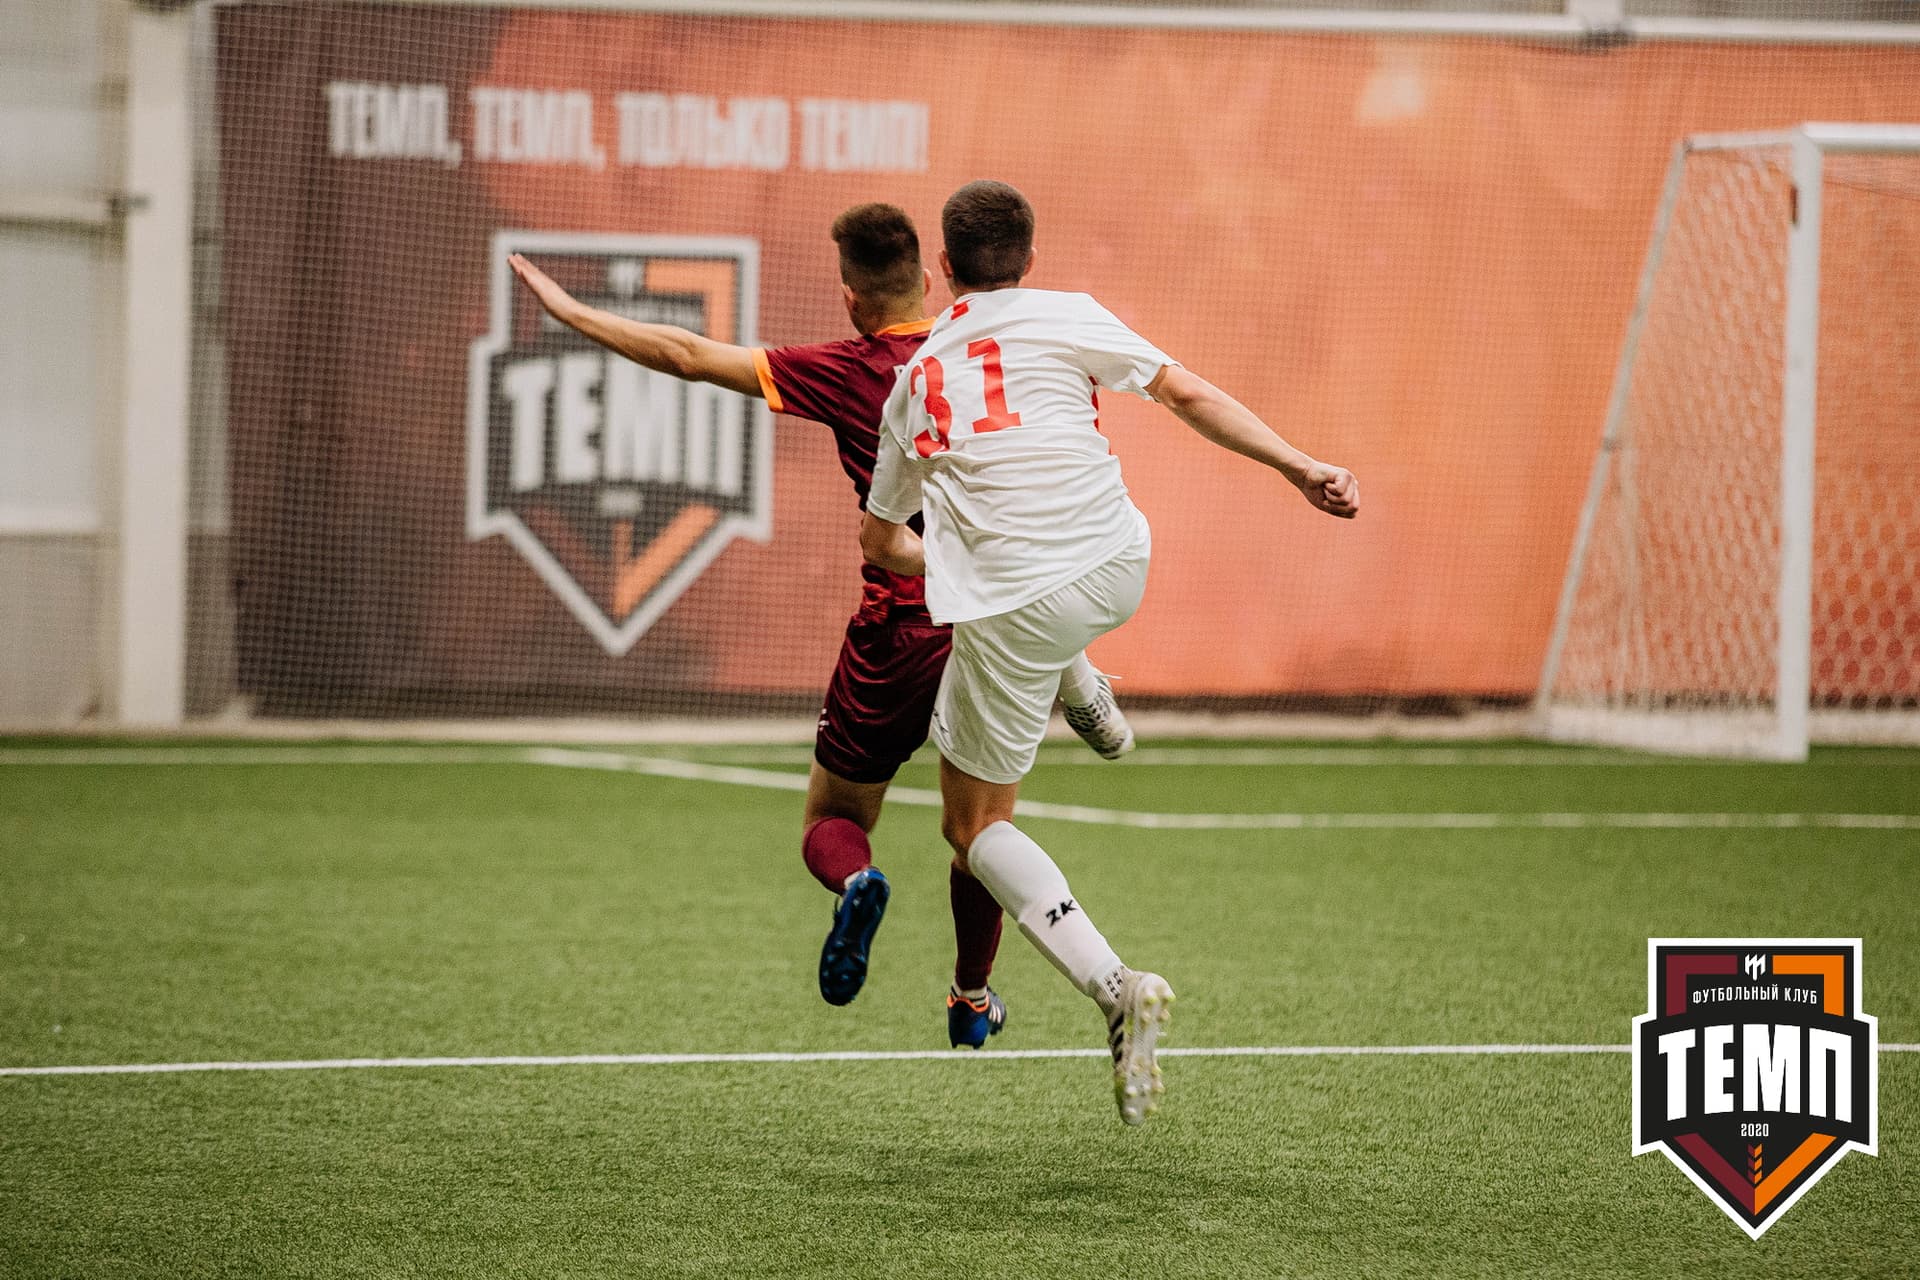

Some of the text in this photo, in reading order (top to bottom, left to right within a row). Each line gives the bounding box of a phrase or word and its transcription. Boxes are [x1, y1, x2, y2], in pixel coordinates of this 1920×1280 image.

[329, 82, 461, 168] ТЕМП,
[471, 87, 606, 171] ТЕМП,
[615, 92, 789, 170] ТОЛЬКО
[910, 337, 1022, 458] 31
